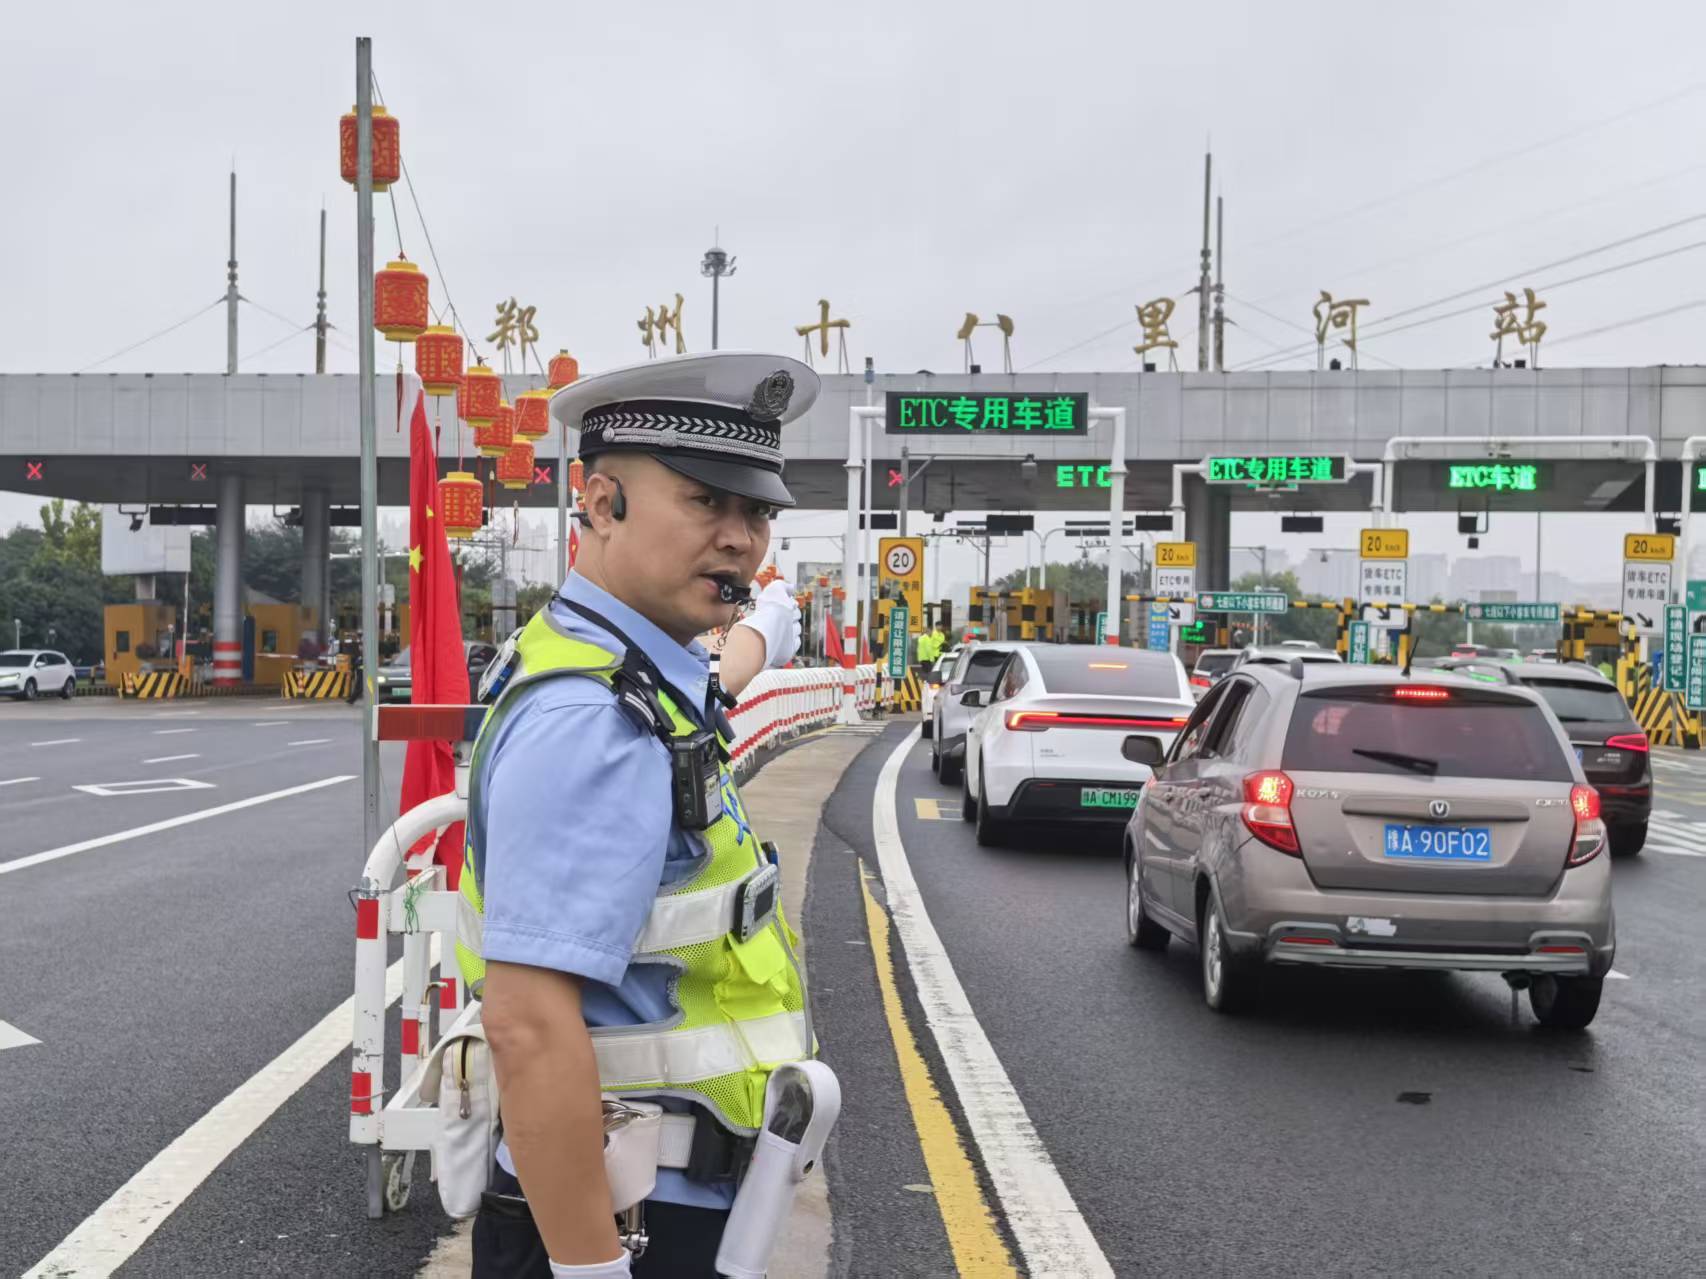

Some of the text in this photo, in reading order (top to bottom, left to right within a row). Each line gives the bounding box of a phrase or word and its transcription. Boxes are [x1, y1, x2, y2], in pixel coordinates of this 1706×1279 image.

[486, 288, 1547, 357] 郑州十八里河站
[900, 396, 1076, 430] ETC专用车道
[1057, 465, 1112, 487] ETC
[1209, 456, 1332, 480] ETC专用车道
[1449, 464, 1536, 490] ETC车道
[1161, 549, 1174, 561] 20
[1367, 536, 1381, 552] 20
[1633, 540, 1648, 553] 20
[893, 553, 910, 568] 20
